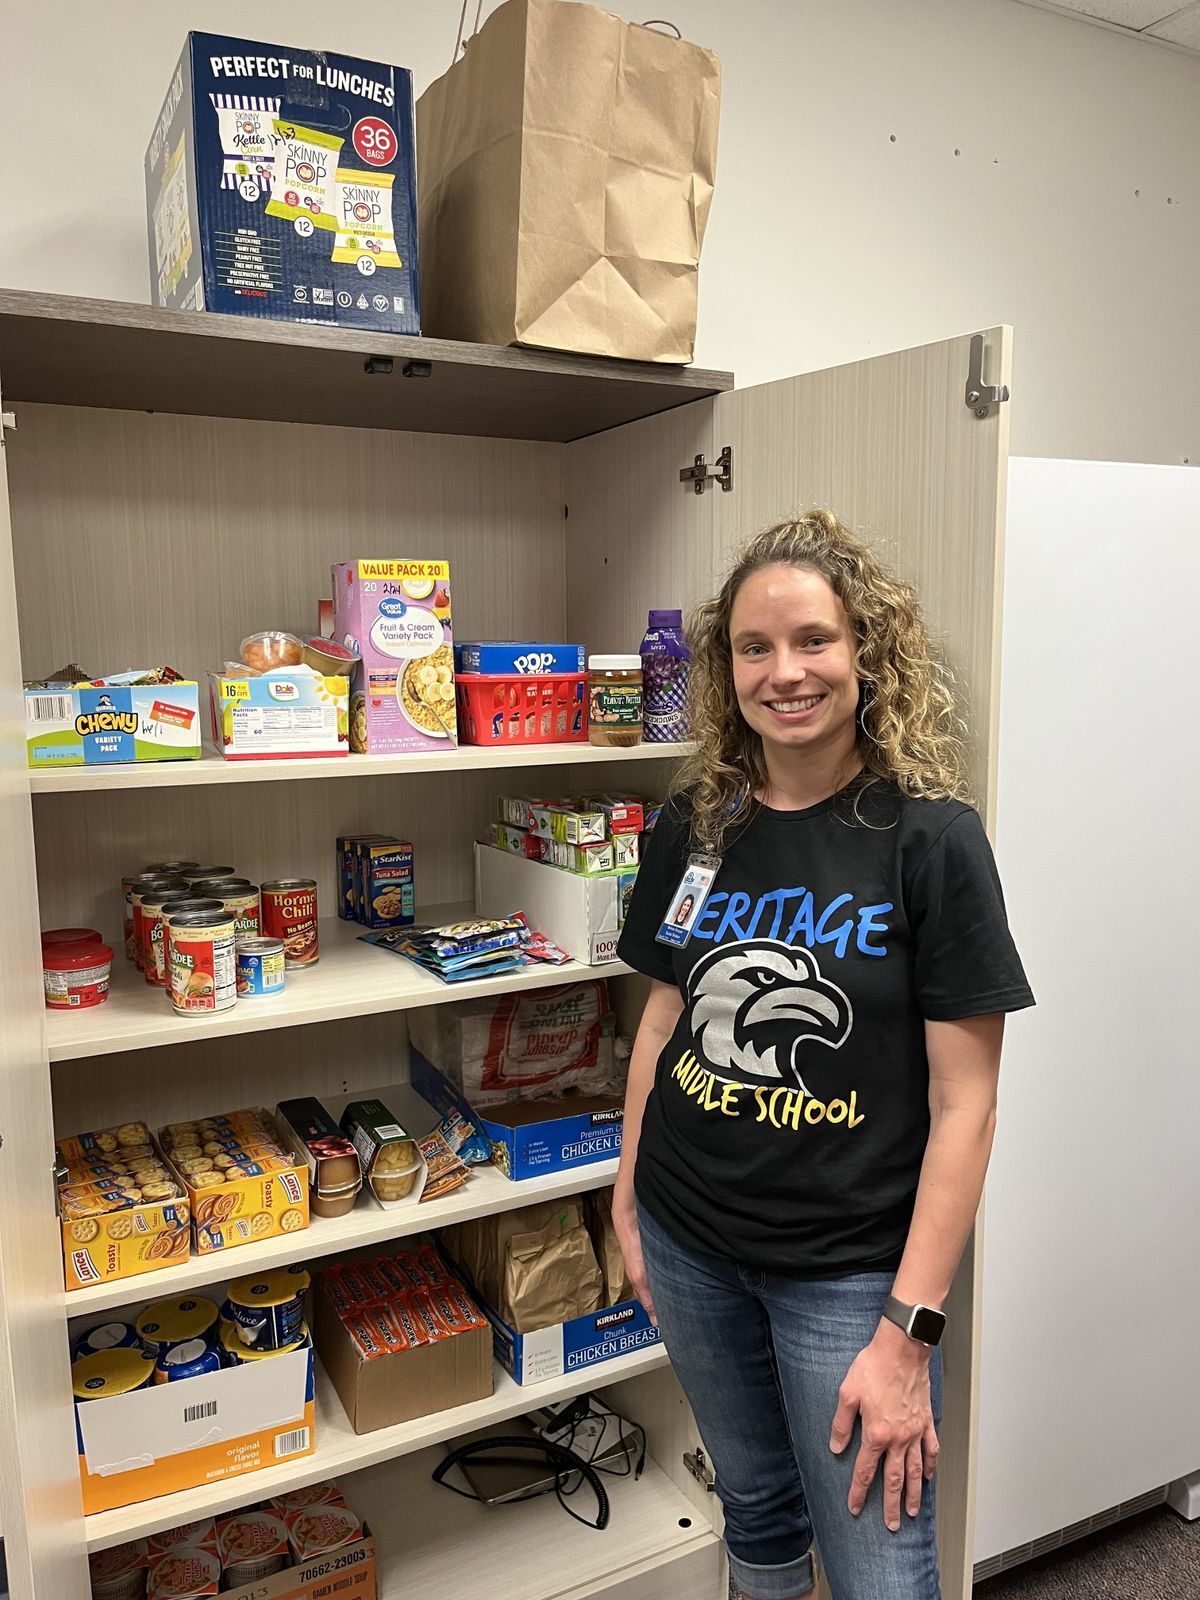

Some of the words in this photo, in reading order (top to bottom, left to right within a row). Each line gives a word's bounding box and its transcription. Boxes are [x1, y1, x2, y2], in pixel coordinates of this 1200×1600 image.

[210, 56, 290, 79] PERFECT
[293, 64, 313, 80] FOR
[316, 65, 395, 107] LUNCHES
[233, 134, 266, 148] Kettle
[360, 125, 391, 151] 36
[287, 143, 328, 166] SKINNY
[366, 149, 385, 160] BAGS
[286, 158, 327, 185] POP
[244, 185, 256, 197] 12
[284, 178, 326, 195] POPCORN
[342, 186, 380, 203] SKINNY
[343, 201, 381, 223] POP
[298, 221, 310, 233] 12
[344, 221, 384, 230] POPCORN
[361, 260, 372, 271] 12
[362, 564, 394, 575] VALUE
[397, 564, 425, 575] PACK
[428, 565, 441, 576] 20
[364, 582, 377, 592] 20
[381, 602, 401, 610] Great
[380, 623, 397, 631] Fruit
[407, 623, 435, 631] Cream
[382, 632, 411, 641] Variety
[225, 685, 236, 696] 16
[95, 736, 122, 744] VARIETY
[100, 744, 118, 752] PACK
[379, 854, 412, 864] StarKist
[273, 893, 315, 907] Horme
[282, 904, 313, 919] Chili
[297, 920, 313, 931] Beans
[692, 886, 894, 959] ERITAGE
[754, 1085, 865, 1131] SCHOOL
[592, 1110, 624, 1121] KIRKLAN
[580, 1127, 614, 1140] Premium
[561, 1137, 611, 1159] CHICKEN
[265, 1179, 273, 1208] Toasty
[284, 1173, 300, 1201] Lance
[75, 1251, 94, 1282] Lance
[106, 1243, 116, 1276] Toasty
[596, 1309, 634, 1326] KIRKLAND
[603, 1326, 627, 1340] Chunk
[567, 1342, 618, 1367] CHICKEN
[620, 1327, 661, 1350] BREAST
[226, 1440, 260, 1456] original
[234, 1451, 260, 1462] flavor
[299, 1549, 366, 1583] 70662-23003
[312, 1587, 332, 1598] RAMEN
[333, 1579, 353, 1592] NOODLE
[354, 1571, 368, 1583] SOUP
